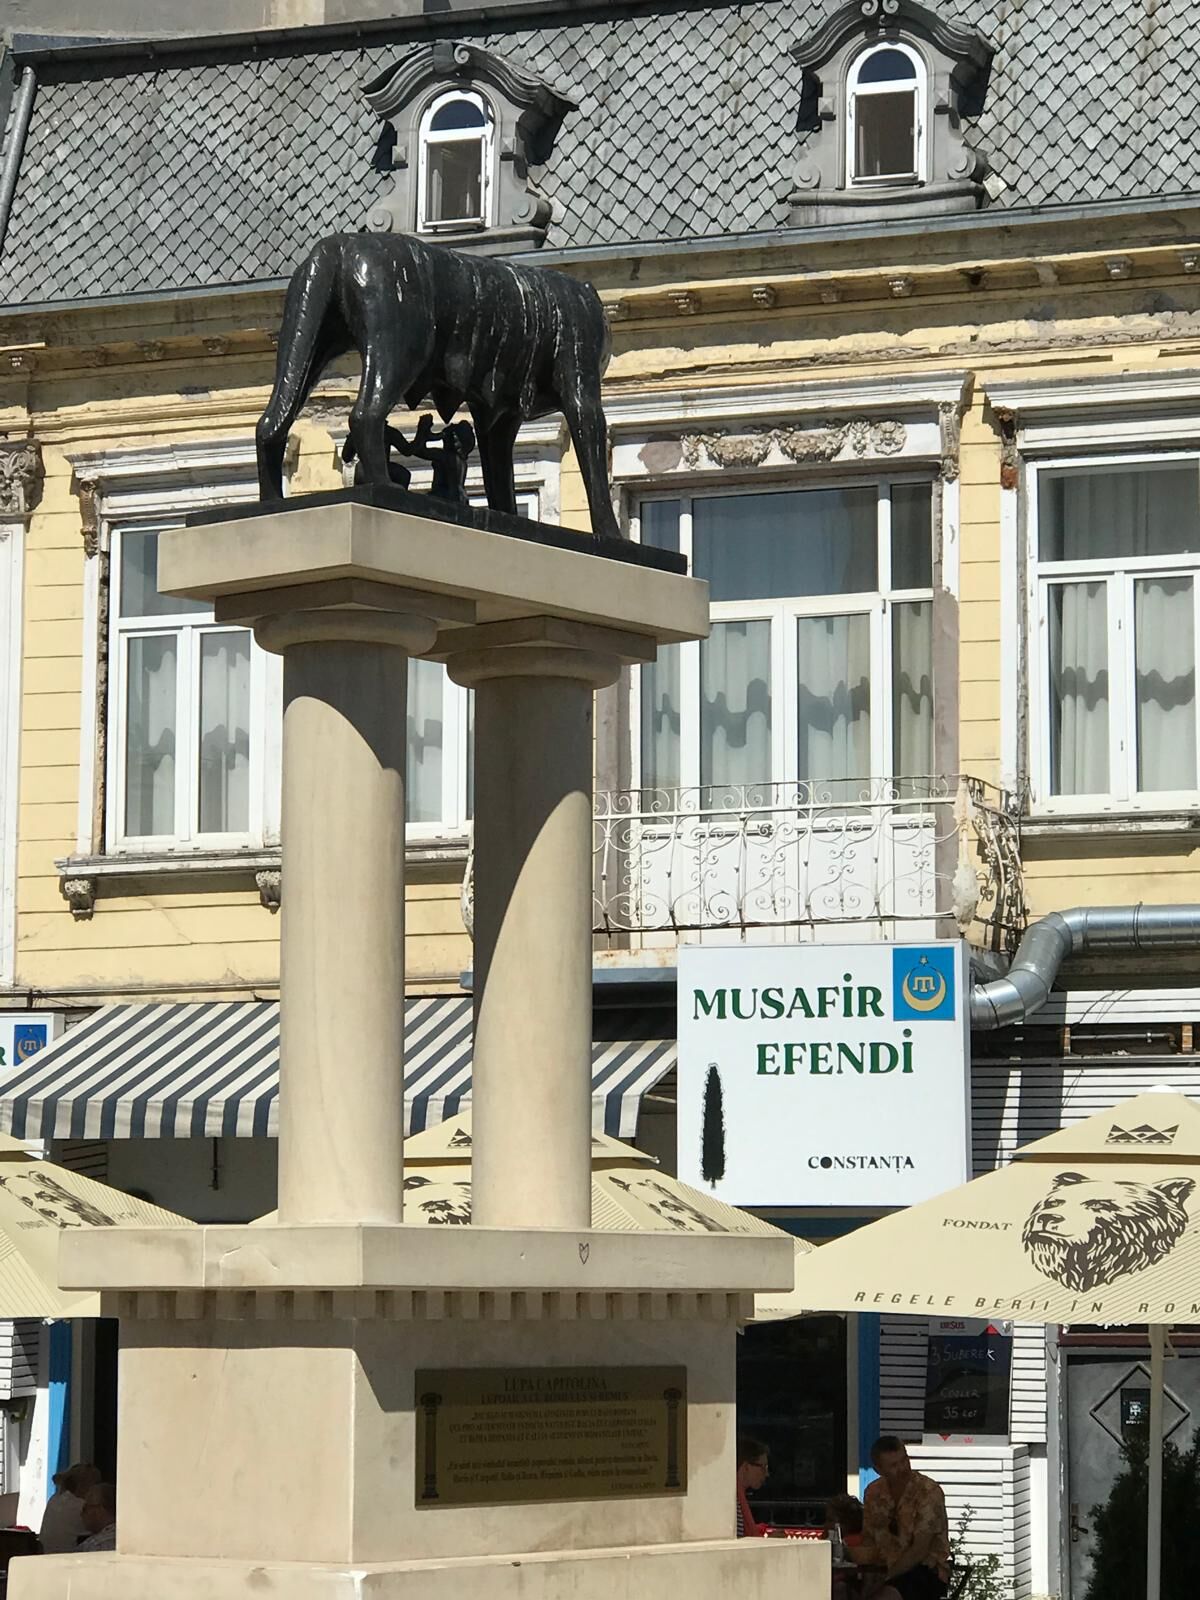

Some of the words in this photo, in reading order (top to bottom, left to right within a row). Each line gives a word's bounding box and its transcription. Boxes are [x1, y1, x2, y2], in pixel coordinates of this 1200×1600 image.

[693, 973, 884, 1020] MUSAFİR
[756, 1028, 914, 1075] EFENDİ
[941, 1218, 1013, 1231] FONDAT
[855, 1291, 955, 1306] REGELE
[975, 1297, 1049, 1311] BERII
[1070, 1299, 1103, 1313] ÎN
